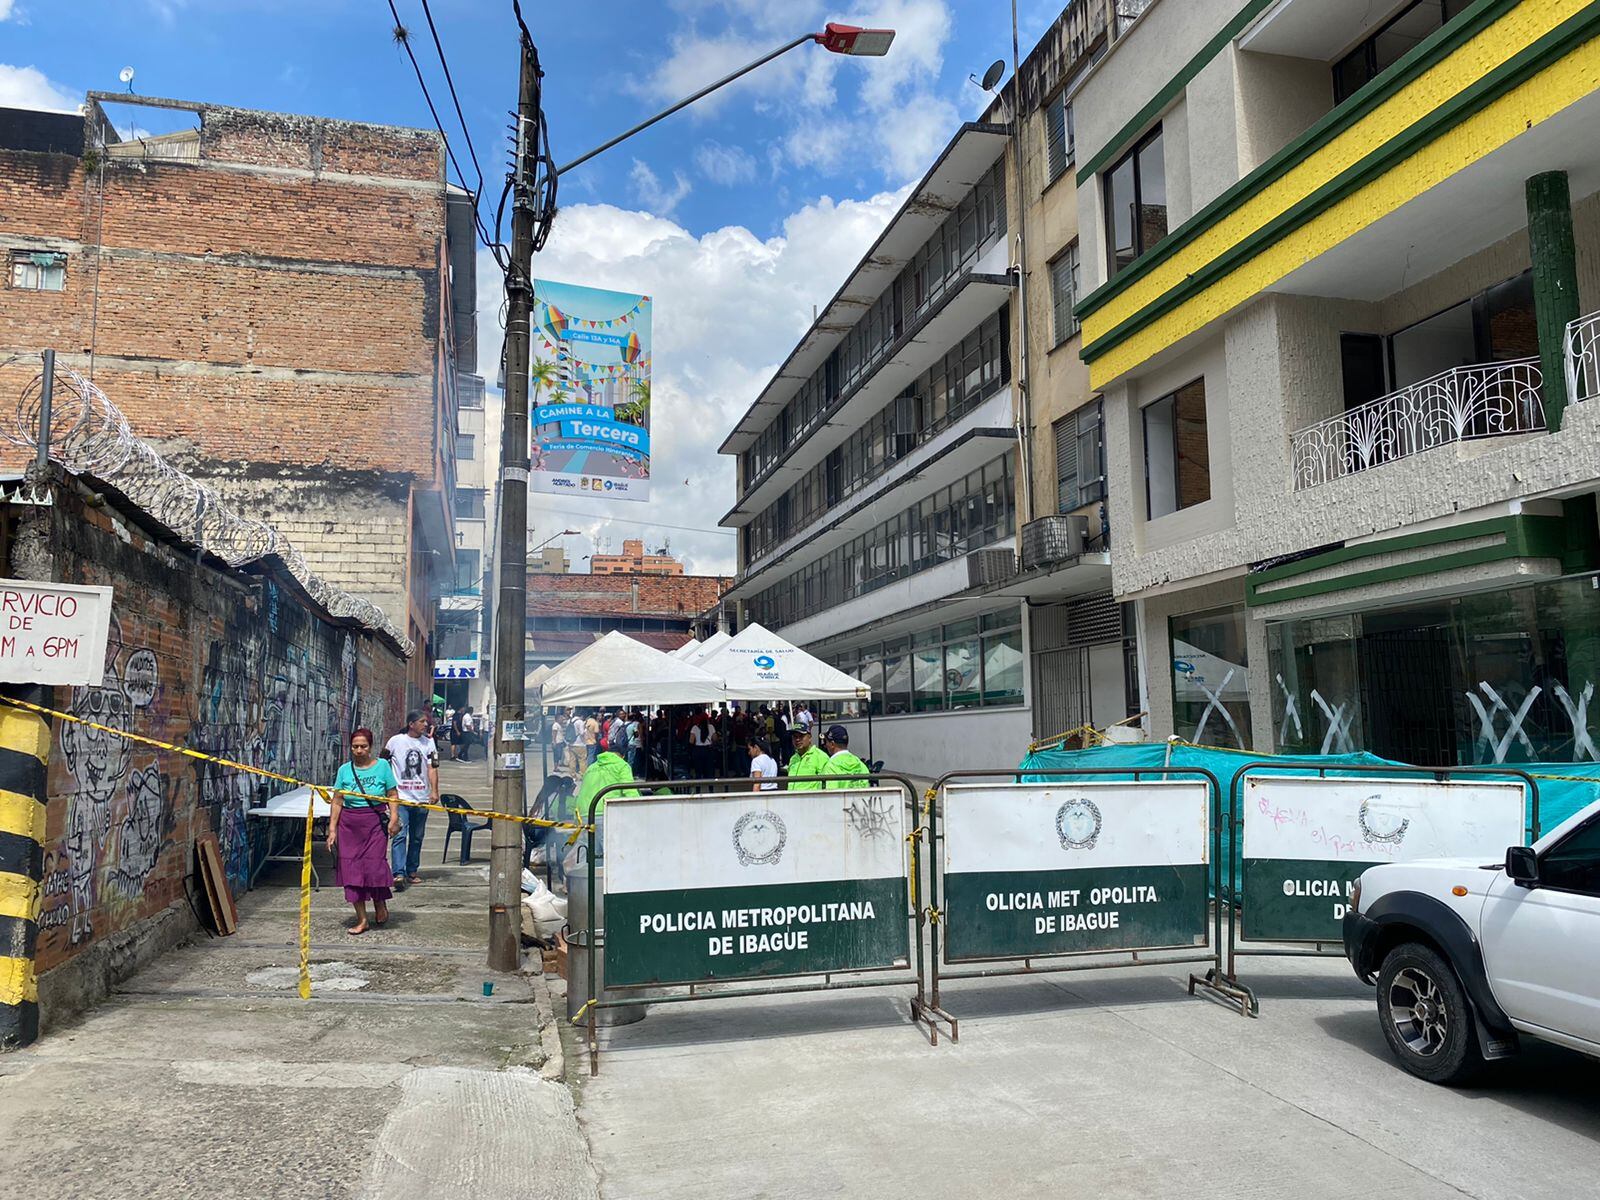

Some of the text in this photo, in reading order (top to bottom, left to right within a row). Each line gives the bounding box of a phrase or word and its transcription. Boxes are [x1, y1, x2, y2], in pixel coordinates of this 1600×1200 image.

[572, 332, 589, 340] Calle
[540, 407, 583, 419] CAMINE
[596, 409, 610, 419] LA
[570, 420, 639, 445] Tercera
[575, 444, 605, 452] Comercio
[10, 615, 33, 631] DE
[25, 645, 35, 657] A
[43, 636, 78, 659] 6PM
[986, 886, 1158, 911] OLICIA MET OPOLITA
[640, 901, 876, 934] POLICIA METROPOLITANA
[1035, 911, 1119, 935] DE IBAGUE
[708, 931, 809, 956] DE IBAGUE
